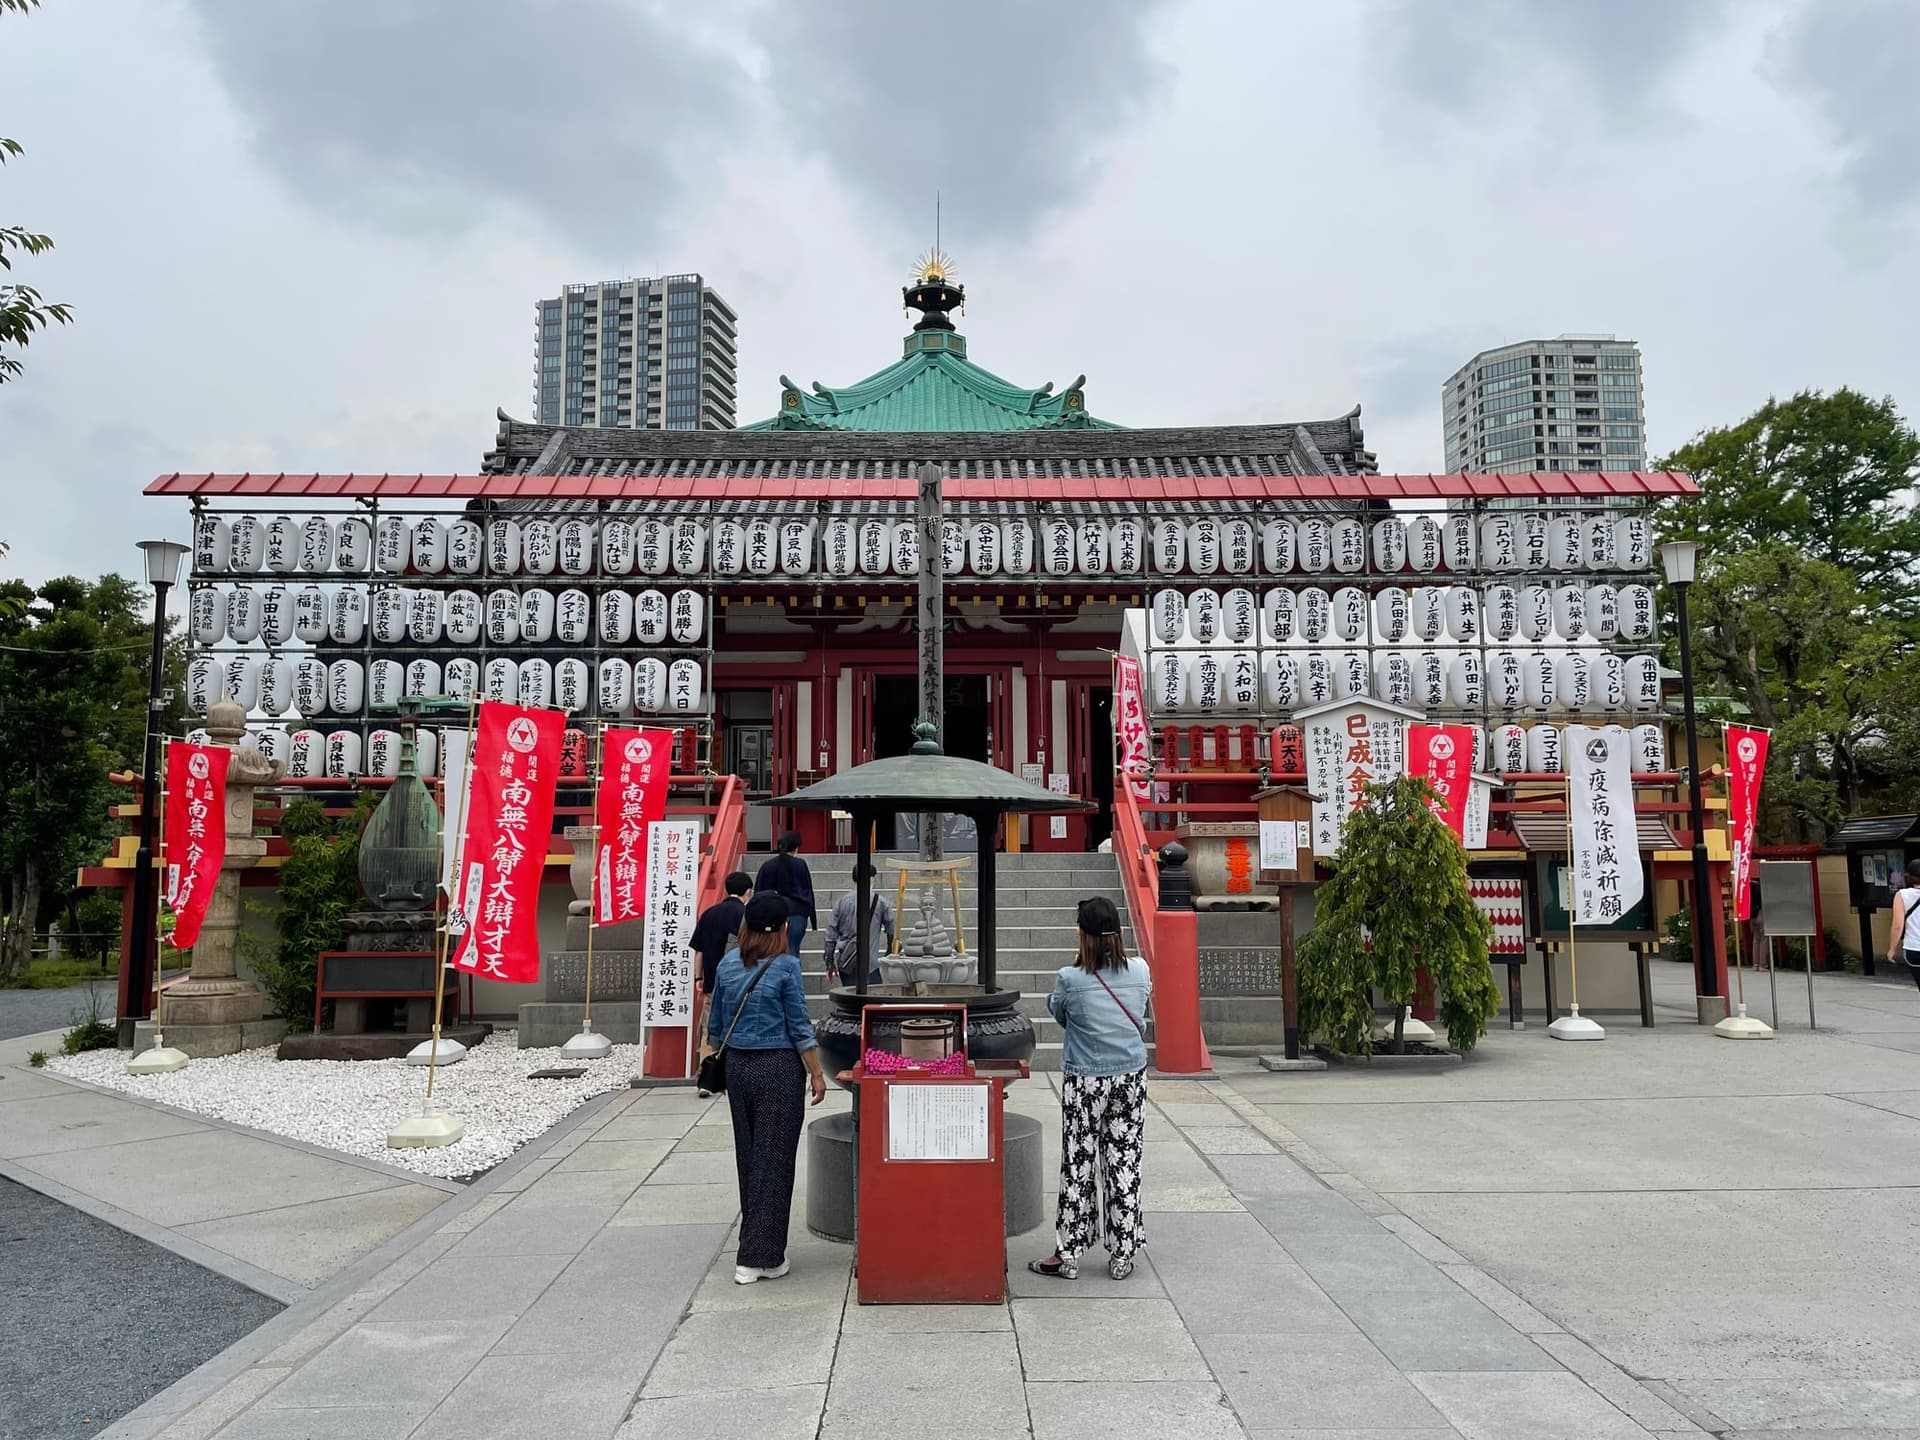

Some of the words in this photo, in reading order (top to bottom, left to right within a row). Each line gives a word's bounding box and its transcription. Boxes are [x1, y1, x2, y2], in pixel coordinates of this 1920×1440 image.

[198, 522, 217, 567] 根津組
[269, 522, 283, 566] 玉山栄一
[416, 522, 434, 567] 松本廣
[452, 524, 468, 568] つる瀬
[493, 522, 508, 571] 朝日信用金庫
[676, 524, 696, 569] 韻松亭
[717, 524, 735, 572] 上野精養軒
[865, 523, 881, 571] 上野観光連盟
[897, 528, 913, 571] 寛永寺
[977, 524, 994, 572] 谷中七福神
[1052, 524, 1069, 572] 天音会一同
[1083, 531, 1101, 571] 竹寿司
[1163, 523, 1179, 569] 金子國義
[1198, 523, 1214, 570] 四谷シモン
[1232, 524, 1247, 570] 高橋睦郎
[1275, 522, 1290, 569] デューク更家
[1496, 520, 1511, 566] コムウェル
[1526, 534, 1545, 565] 石長
[1592, 523, 1606, 562] 大野屋
[1630, 521, 1643, 565] はせがわ
[297, 594, 311, 629] 福井
[562, 592, 576, 640] クマイ商店
[675, 592, 692, 640] 曽根勝人
[1347, 590, 1360, 635] なかほり
[1534, 588, 1547, 638] グリーンロード
[297, 663, 313, 712] 日本三曲協会
[1200, 660, 1217, 708] 赤沼勇弥
[1235, 660, 1252, 703] 大和田
[1277, 660, 1292, 706] いかるが
[1464, 659, 1479, 705] 引田一史
[1502, 656, 1518, 706] 麻布いがた
[1540, 658, 1553, 705] AZZLO
[1605, 658, 1620, 705] ひぐらし
[665, 830, 680, 876] 初巳祭
[1589, 769, 1622, 917] 疫病除滅祈願
[658, 880, 679, 1017] 大般若転読法要
